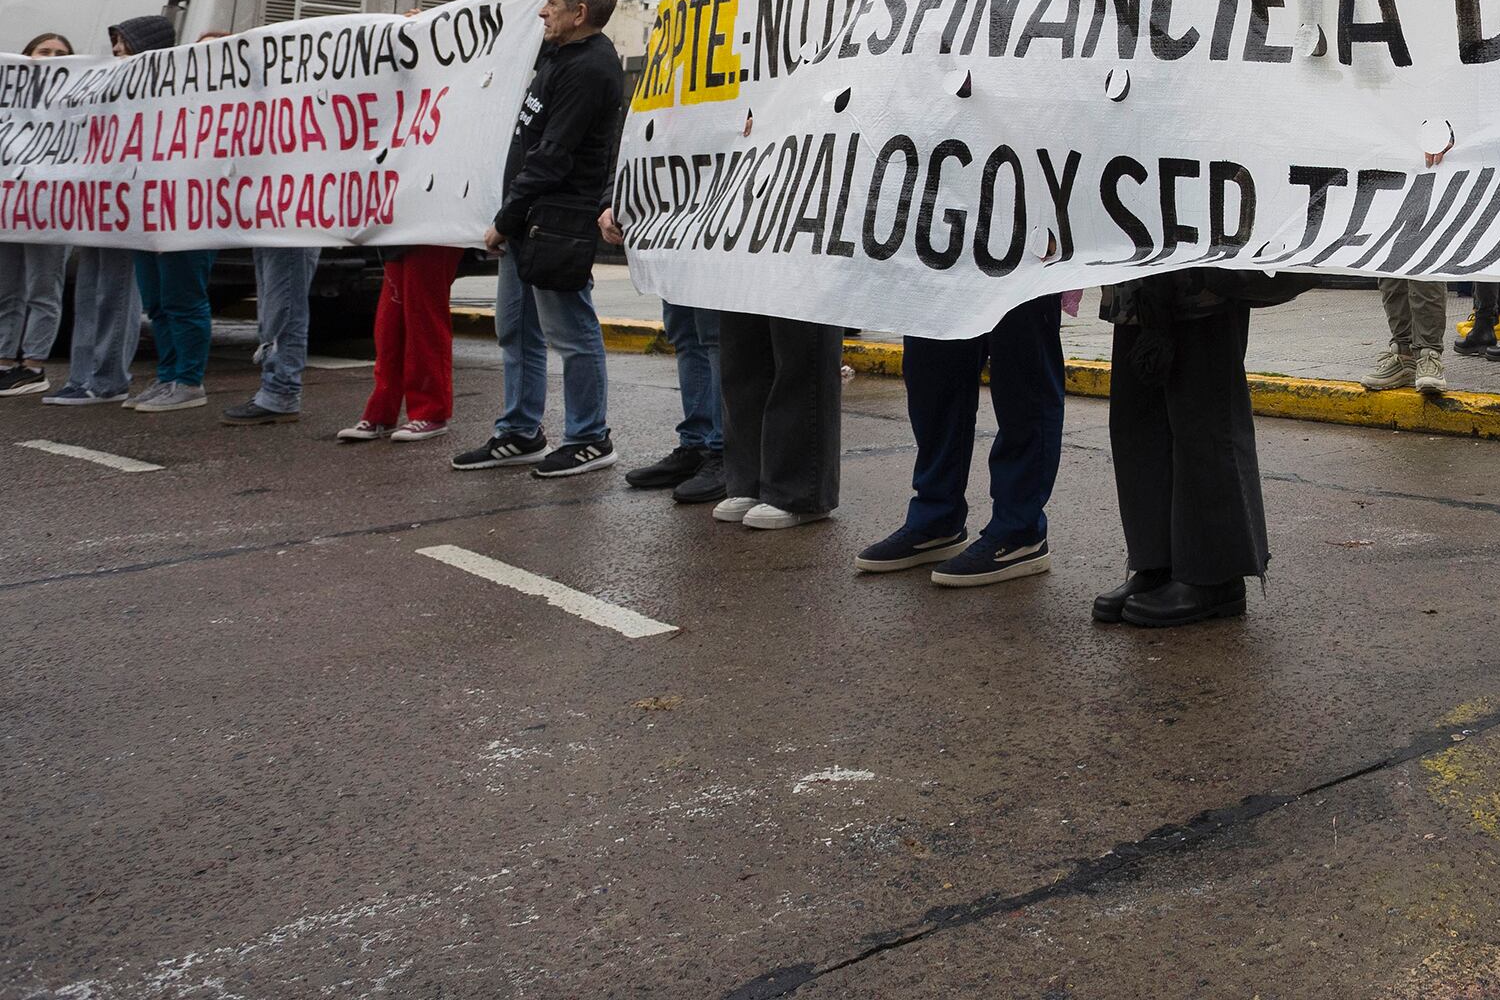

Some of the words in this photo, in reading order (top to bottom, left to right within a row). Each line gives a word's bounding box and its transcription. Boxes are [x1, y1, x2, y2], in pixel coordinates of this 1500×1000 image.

[182, 46, 199, 96] A
[206, 37, 250, 92] LAS
[262, 20, 419, 87] PERSONAS
[429, 2, 504, 67] CON
[83, 114, 120, 165] NO
[119, 112, 144, 163] A
[152, 106, 187, 162] LA
[194, 95, 327, 160] PERDIDA
[331, 92, 379, 151] DE
[391, 86, 450, 150] LAS
[0, 179, 131, 232] TACIONES
[142, 178, 177, 233] EN
[187, 169, 400, 231] DISCAPACIDAD
[612, 142, 776, 252] QUEREMOS
[748, 132, 1027, 278] DIALOGO
[1036, 148, 1082, 267] Y
